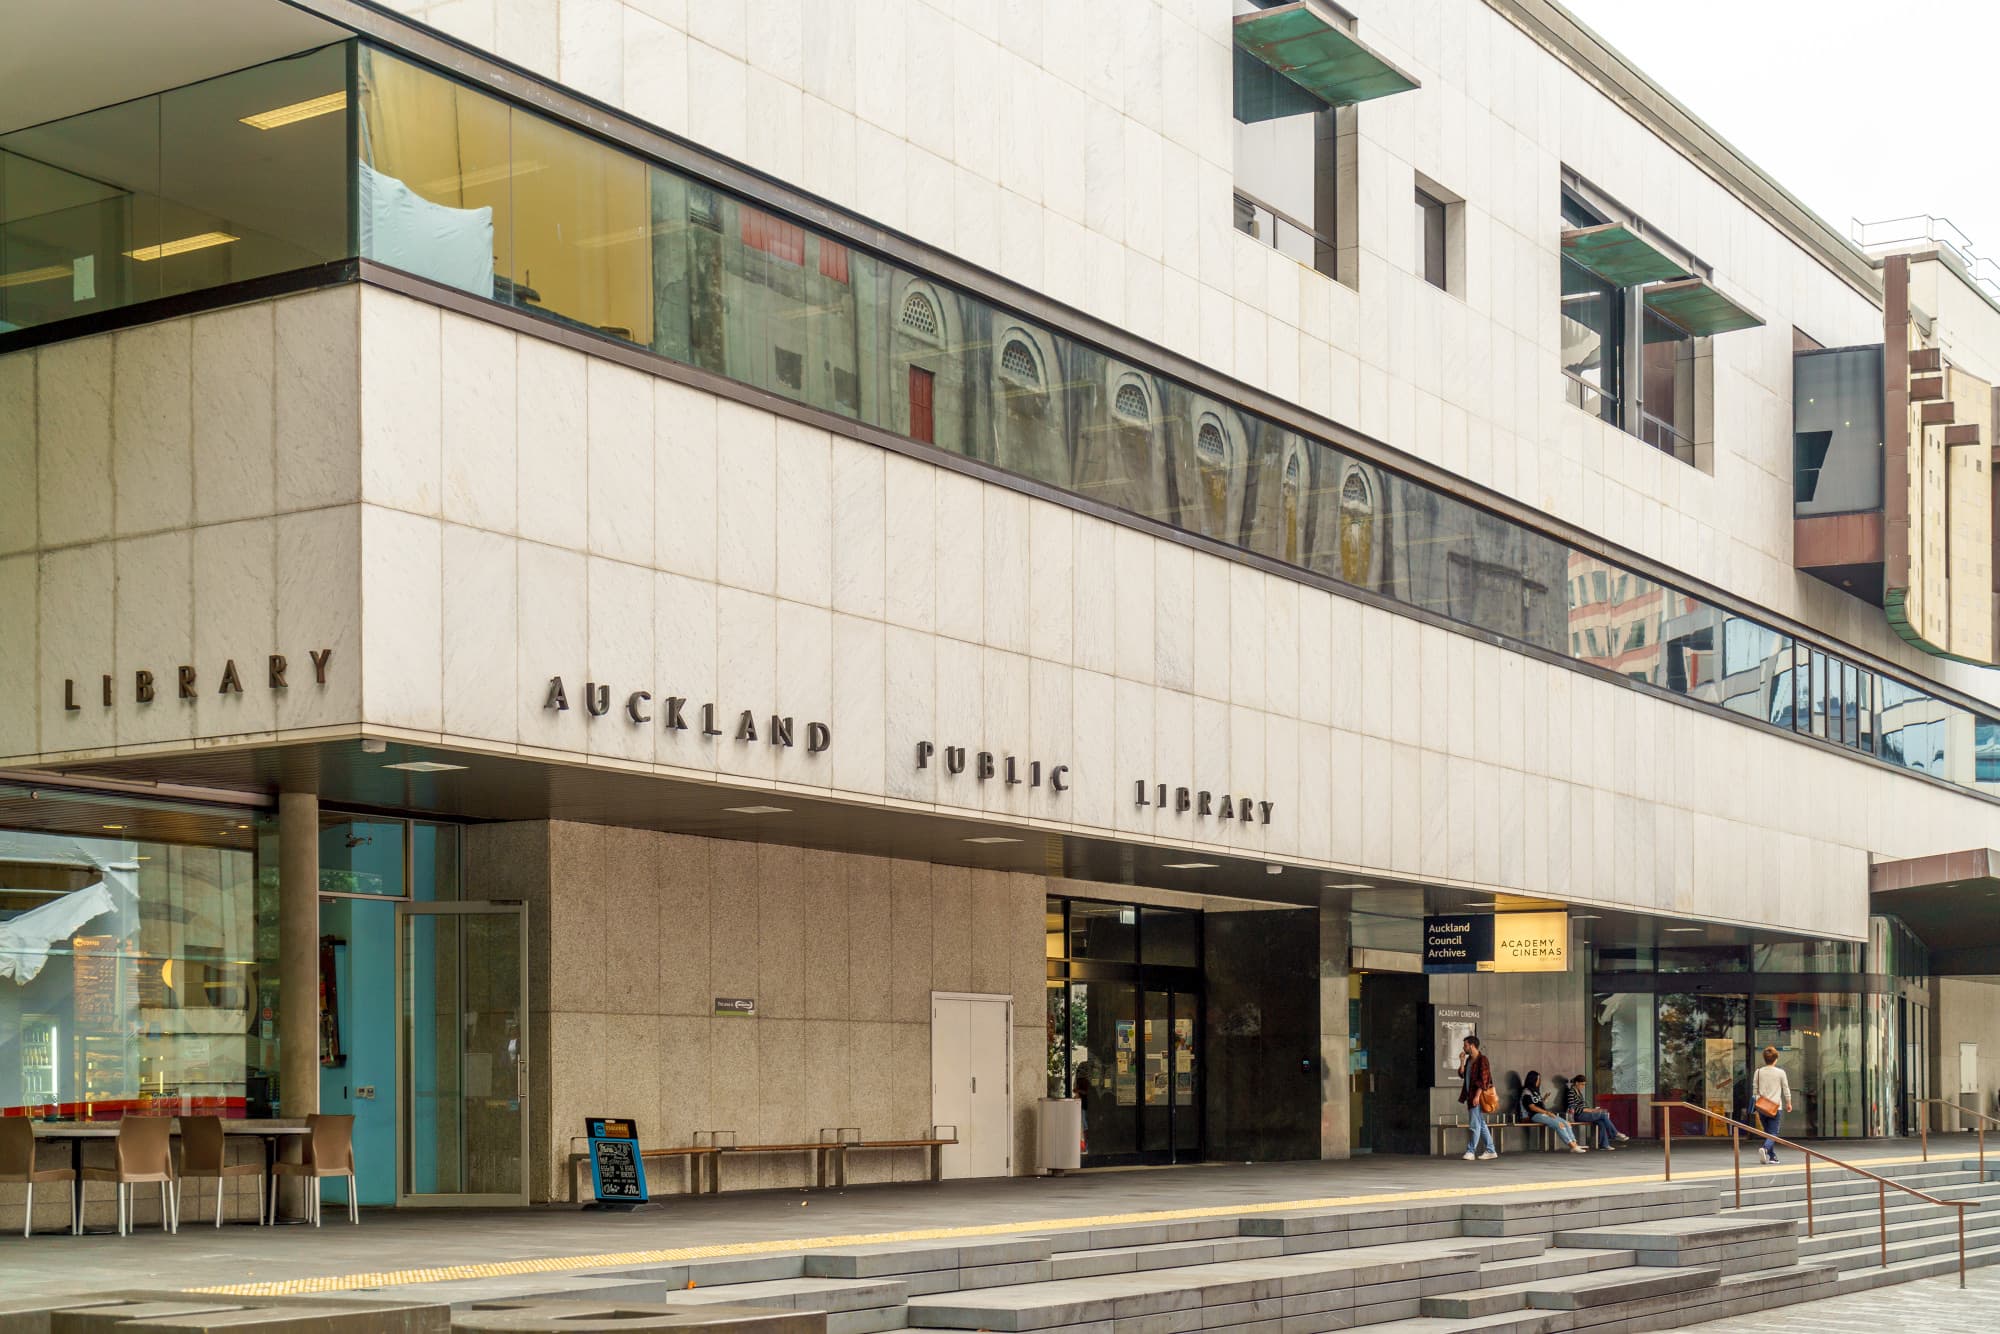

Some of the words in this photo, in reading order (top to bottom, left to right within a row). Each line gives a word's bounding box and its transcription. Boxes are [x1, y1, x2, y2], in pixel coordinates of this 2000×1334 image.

[64, 649, 332, 711] LIBRARY
[544, 676, 832, 753] AUCKLAND
[916, 740, 1069, 792] PUBLIC
[1135, 779, 1274, 825] LIBRARY
[1428, 922, 1471, 933] Auckland
[1428, 935, 1462, 946] Council
[1501, 939, 1555, 948] ACADEMY
[1428, 948, 1467, 958] Archives
[1512, 948, 1562, 957] CINEMAS
[1439, 1009, 1460, 1017] ACADEMY
[1460, 1010, 1480, 1019] CINEMAS
